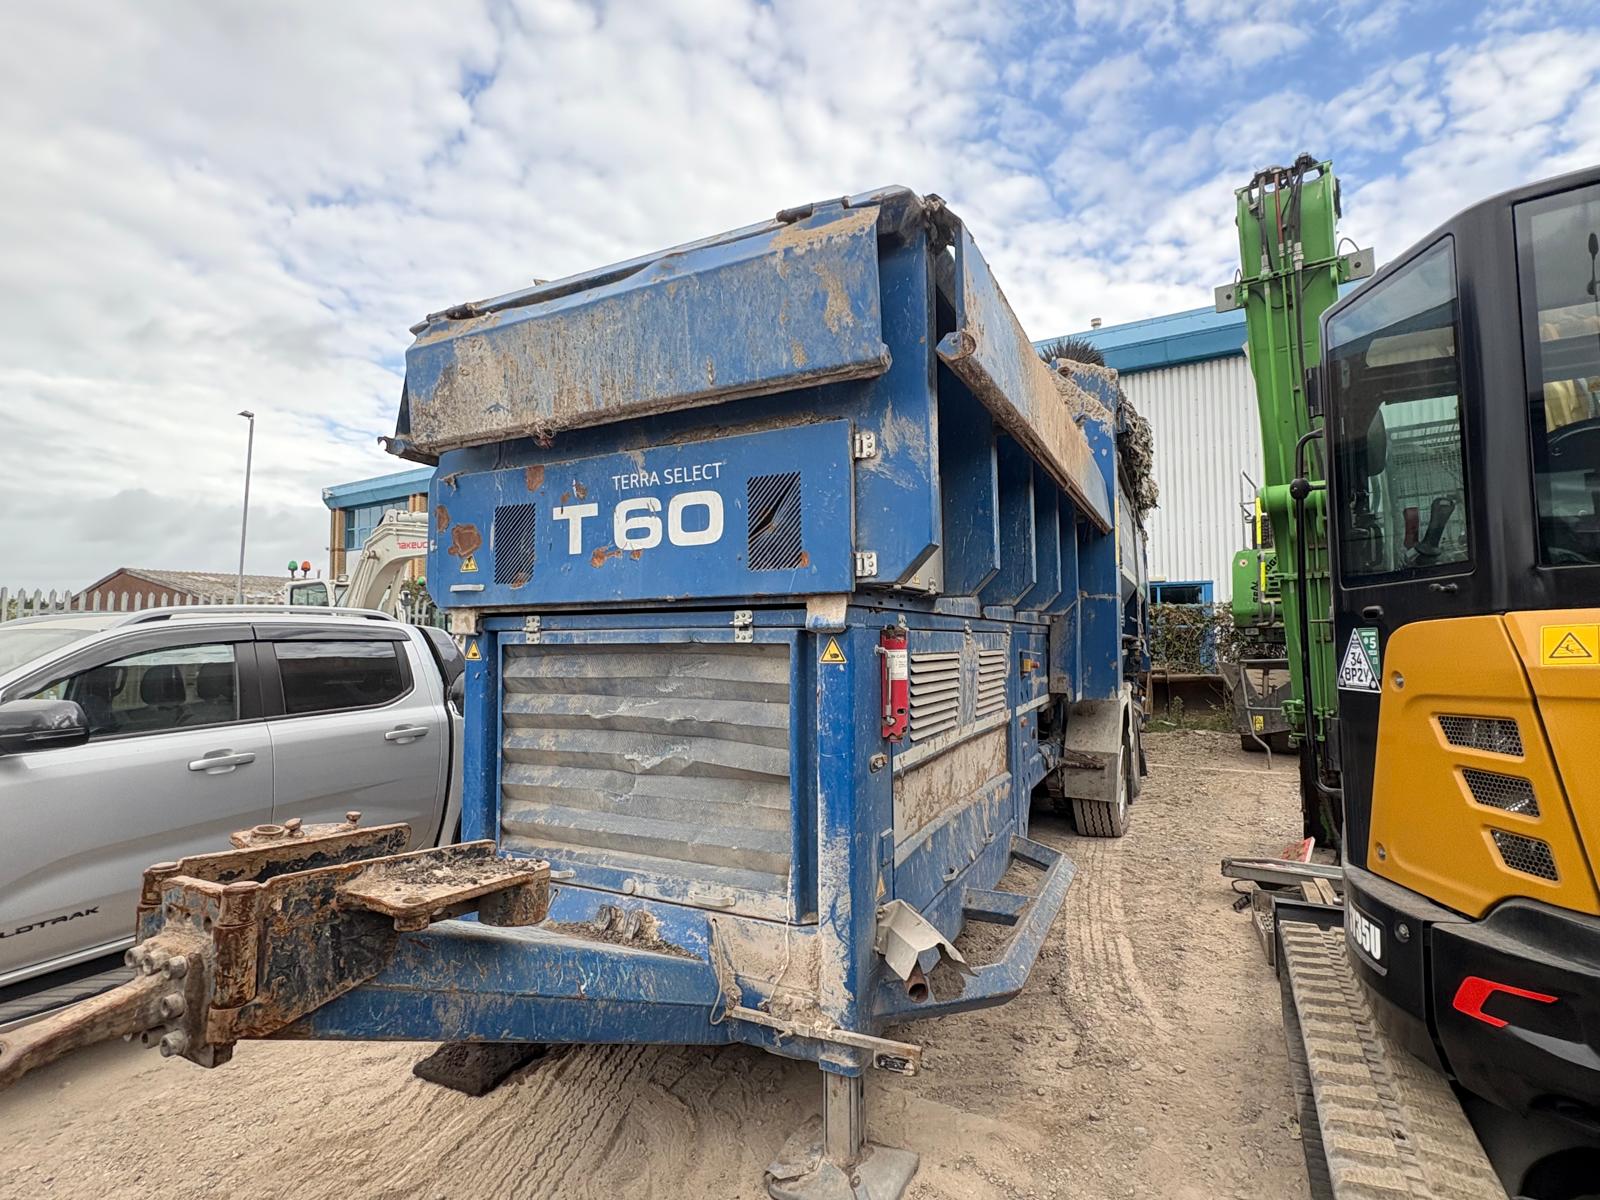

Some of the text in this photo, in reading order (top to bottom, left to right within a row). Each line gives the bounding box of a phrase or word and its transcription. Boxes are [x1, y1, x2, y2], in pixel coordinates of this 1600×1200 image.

[611, 462, 723, 491] TERRA SELECT
[552, 490, 724, 555] T 60
[1350, 651, 1362, 666] 34
